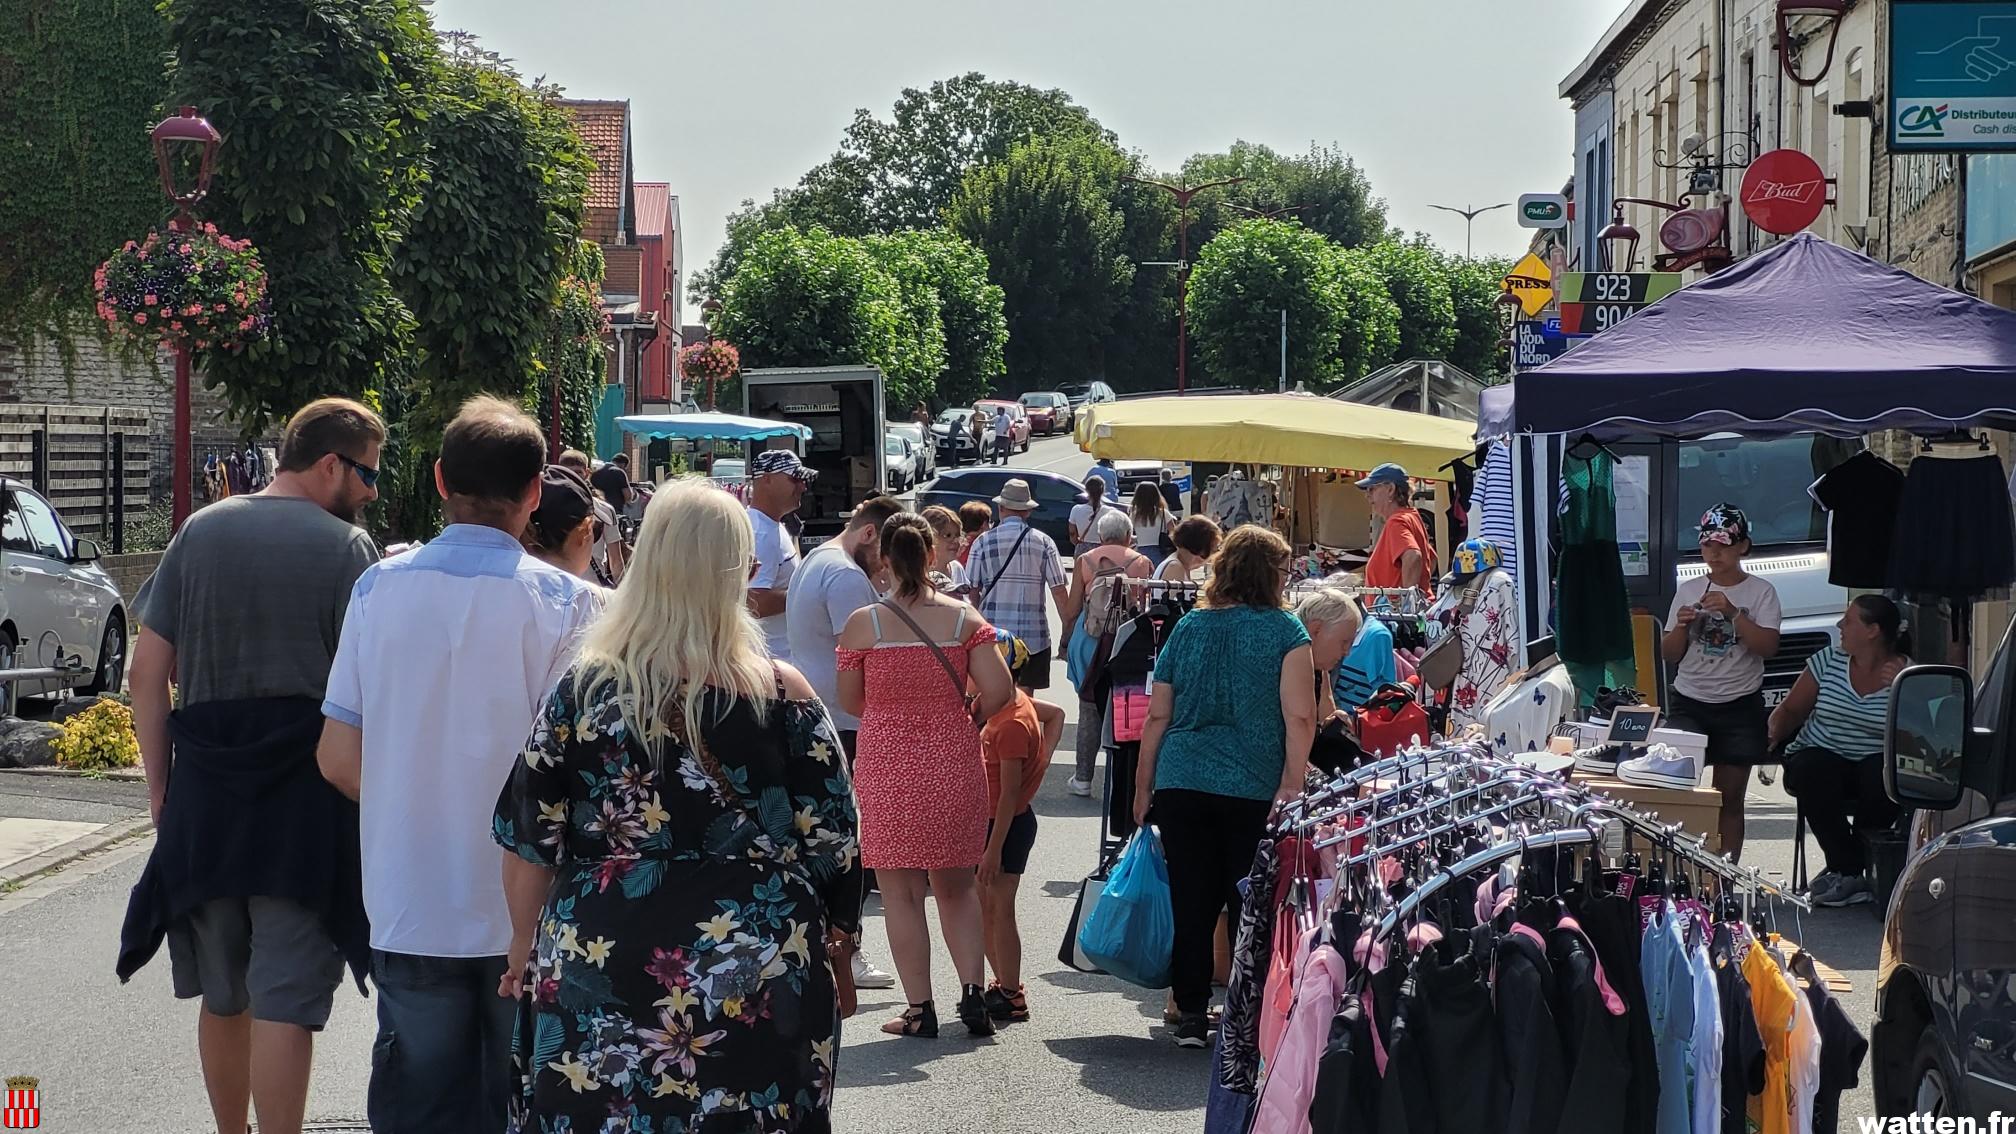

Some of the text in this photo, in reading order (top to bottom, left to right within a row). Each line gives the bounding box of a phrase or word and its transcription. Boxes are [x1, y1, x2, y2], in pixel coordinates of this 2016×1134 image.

[1973, 124, 1999, 134] Cash
[1761, 182, 1805, 198] Bud
[1527, 207, 1547, 215] PMU
[1507, 279, 1551, 289] PRESS
[1595, 274, 1631, 300] 923
[1519, 324, 1532, 335] LA
[1519, 334, 1546, 345] VOIX
[1519, 343, 1536, 354] DU
[1519, 353, 1551, 364] NORD
[1619, 717, 1632, 731] 10
